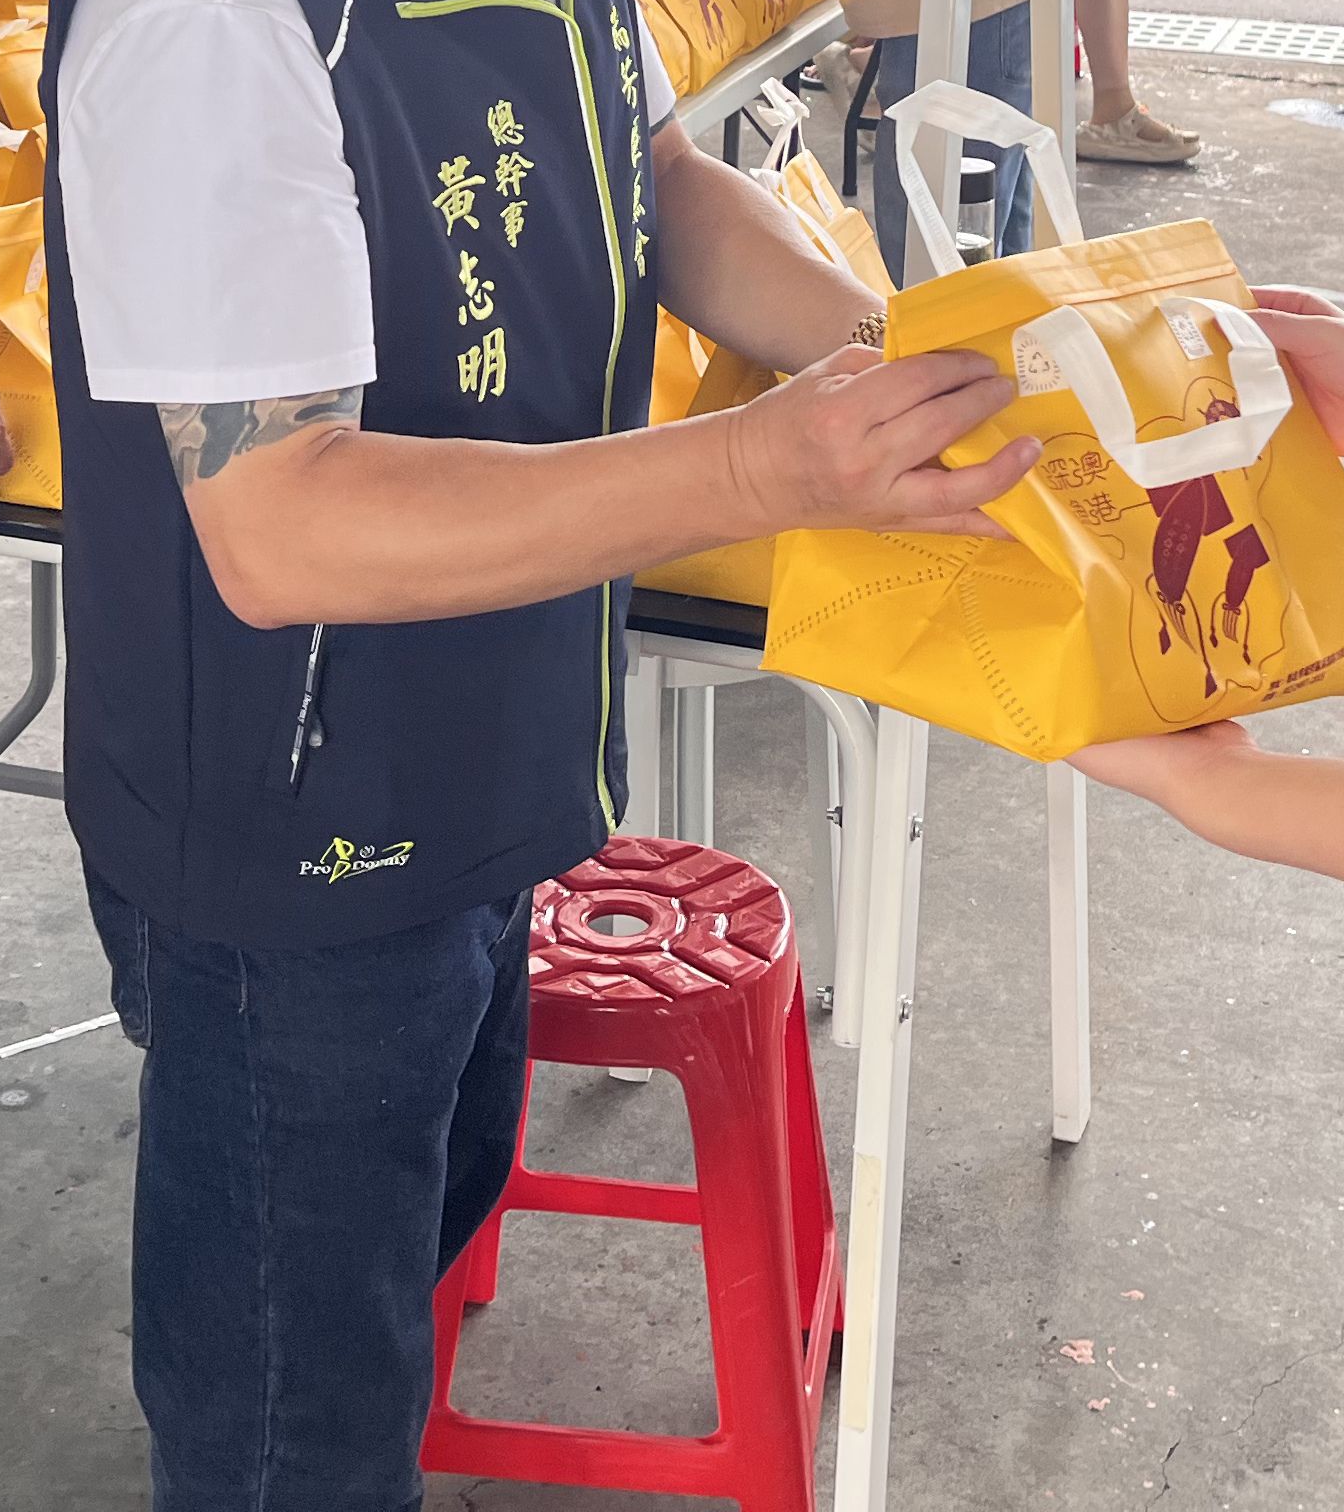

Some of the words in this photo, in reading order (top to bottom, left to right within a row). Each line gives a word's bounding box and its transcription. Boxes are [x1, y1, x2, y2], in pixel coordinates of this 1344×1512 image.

[487, 99, 535, 249] 總幹事
[432, 155, 507, 404] 黃志明
[299, 861, 331, 876] Pro
